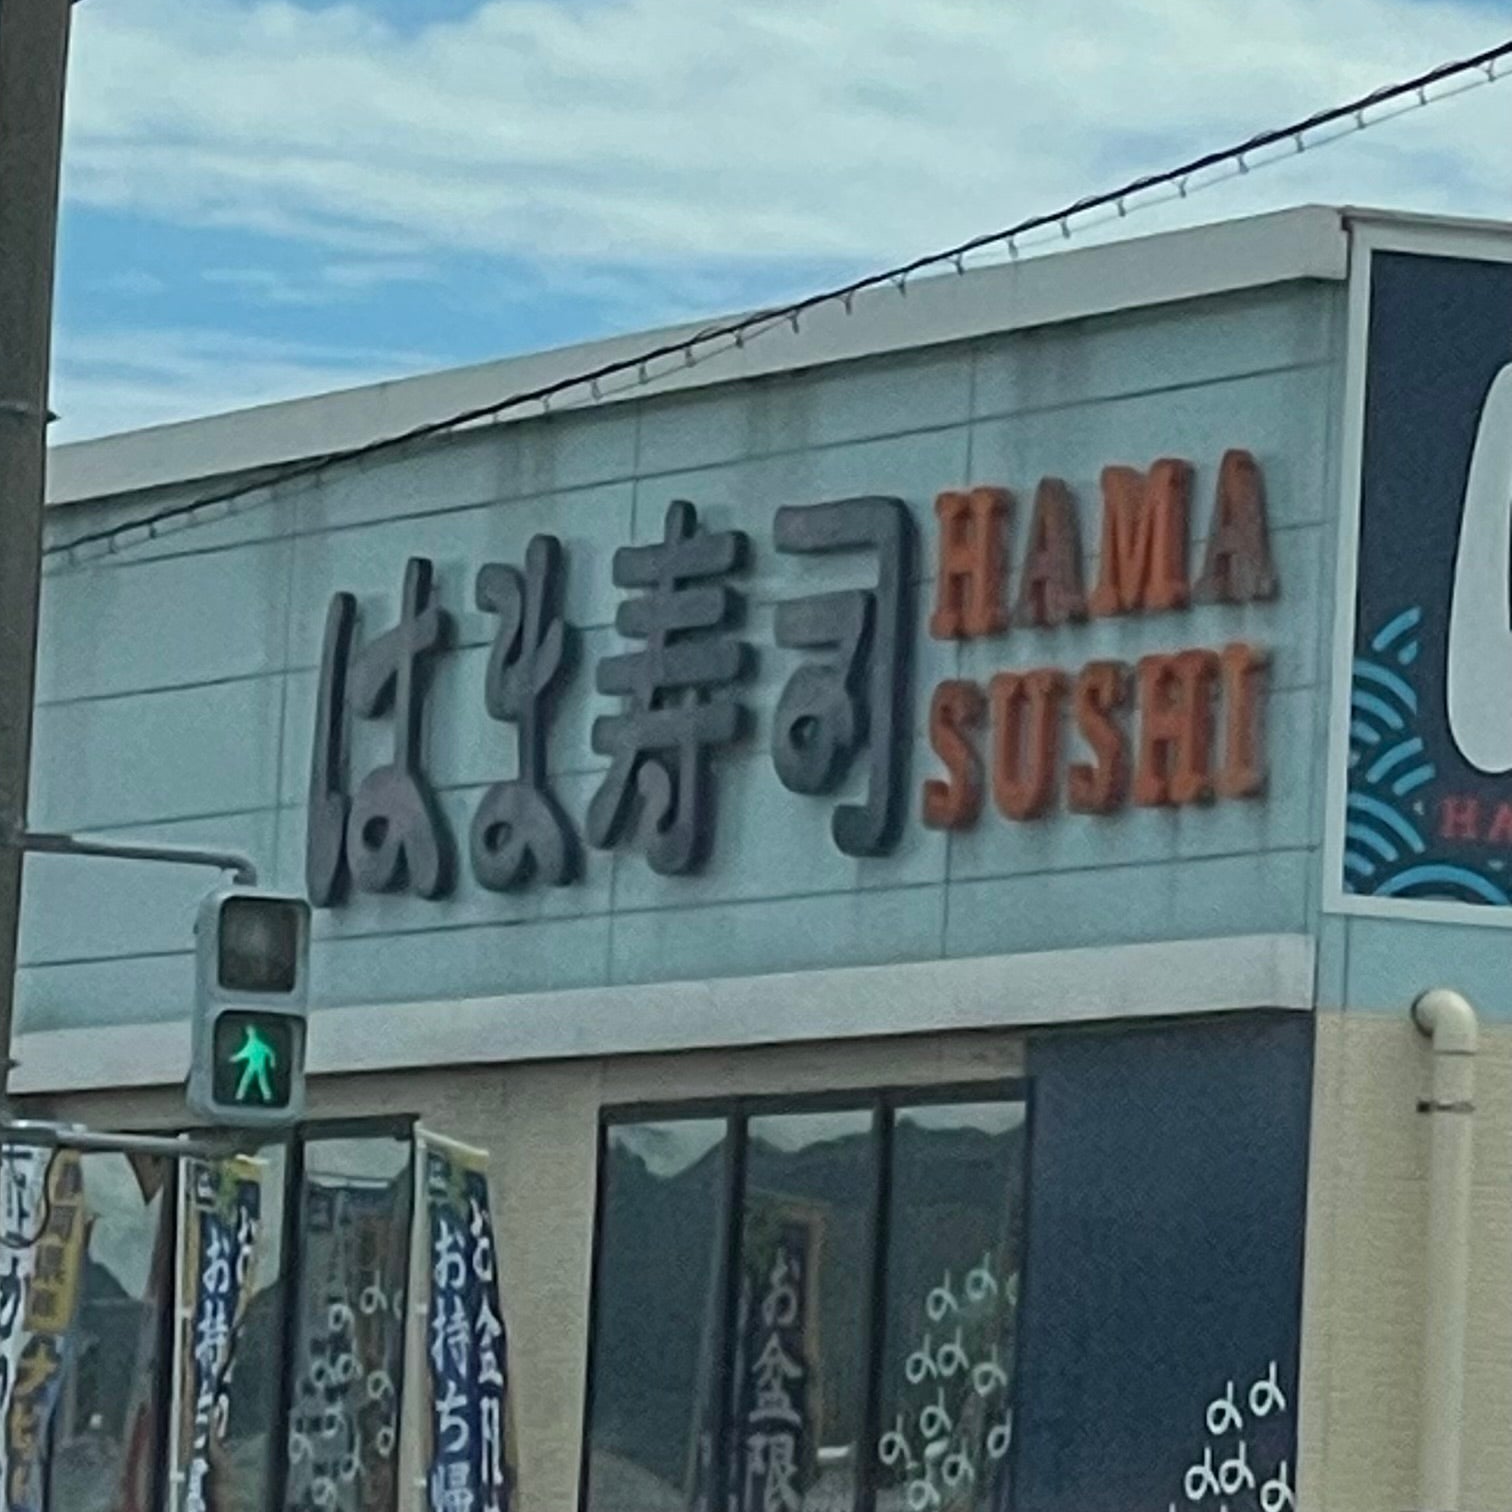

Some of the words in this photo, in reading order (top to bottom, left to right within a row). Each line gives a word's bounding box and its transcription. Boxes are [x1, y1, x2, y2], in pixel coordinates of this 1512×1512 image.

[929, 447, 1280, 640] HAMA
[305, 496, 918, 909] はま寿司
[922, 641, 1268, 832] SUSHI
